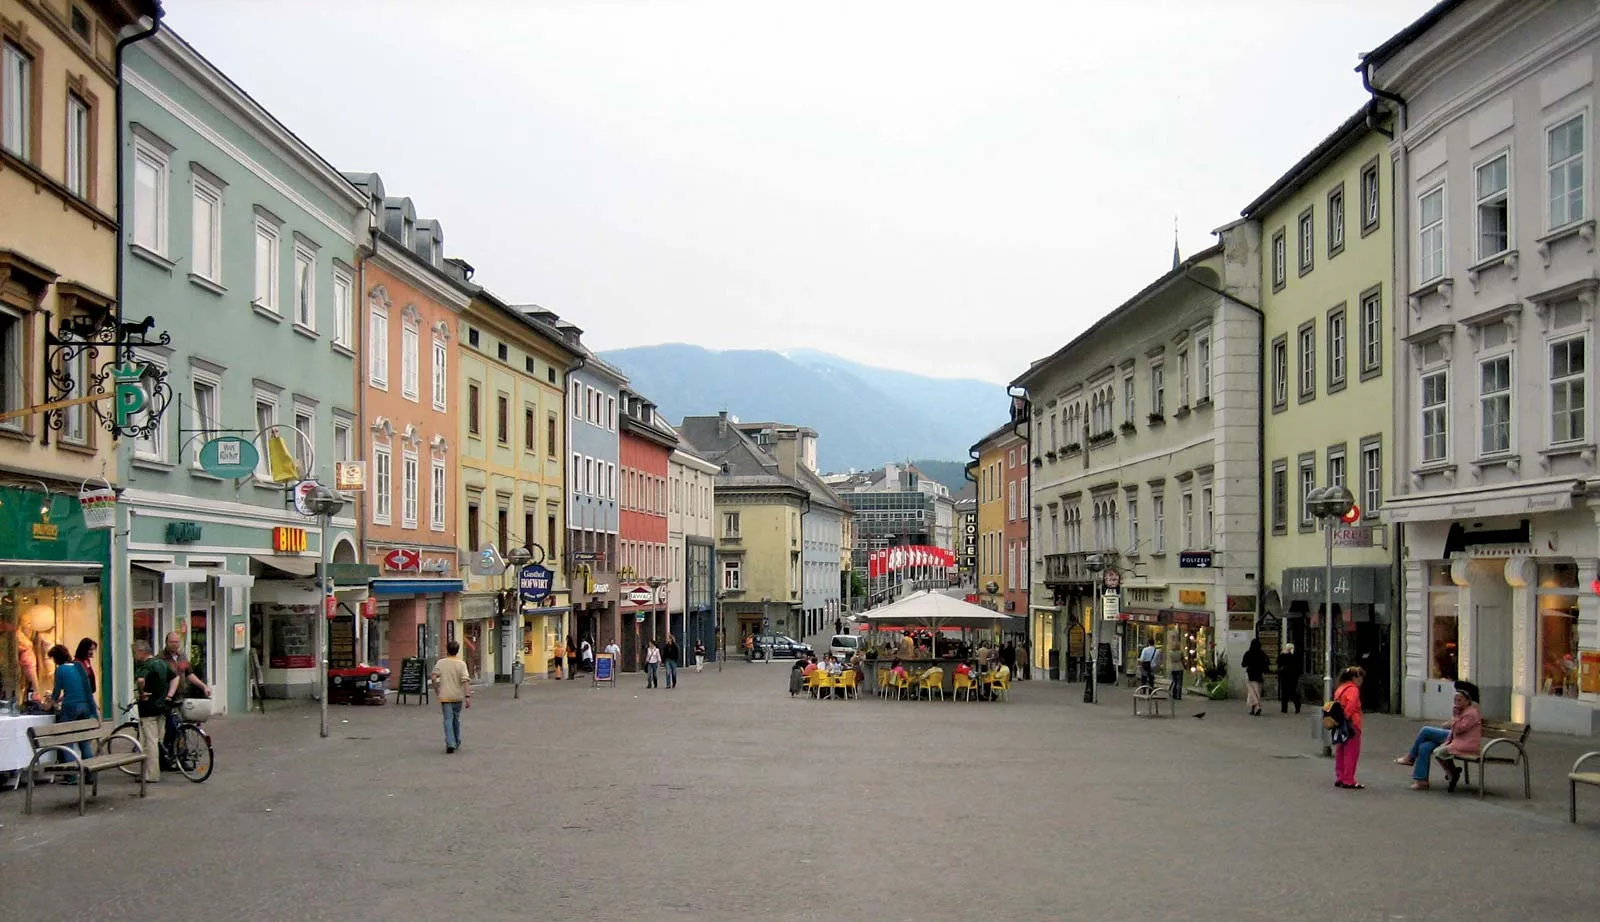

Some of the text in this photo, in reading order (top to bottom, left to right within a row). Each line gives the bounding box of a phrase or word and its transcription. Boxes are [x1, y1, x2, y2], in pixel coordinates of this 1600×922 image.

[116, 383, 146, 428] P
[279, 526, 307, 552] BILLA
[967, 514, 975, 566] HOTEL
[1333, 529, 1369, 539] KREIS
[520, 579, 549, 589] HOFWIRT
